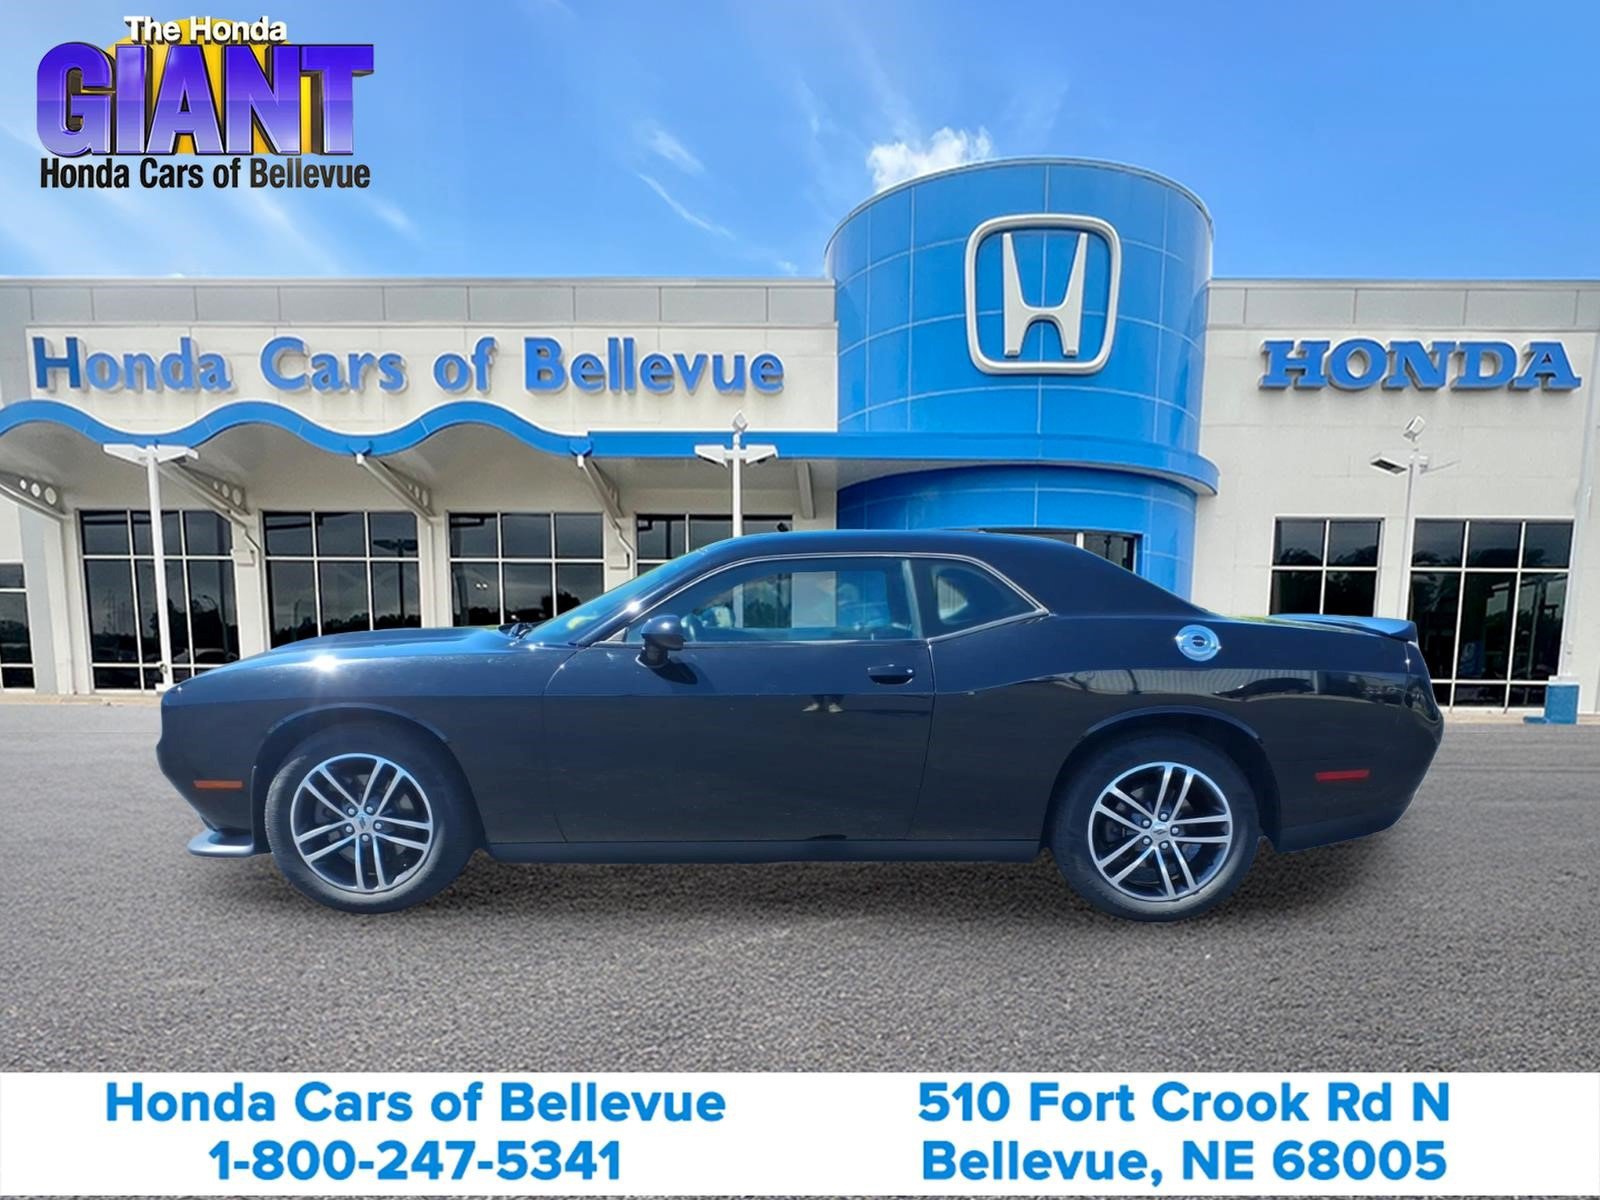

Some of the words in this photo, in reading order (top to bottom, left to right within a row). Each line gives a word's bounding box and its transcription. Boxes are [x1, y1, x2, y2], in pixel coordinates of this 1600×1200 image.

[31, 336, 233, 393] Honda
[260, 336, 408, 393] Cars
[432, 336, 499, 393] of
[523, 336, 786, 395] Bellevue
[1258, 338, 1582, 392] HONDA
